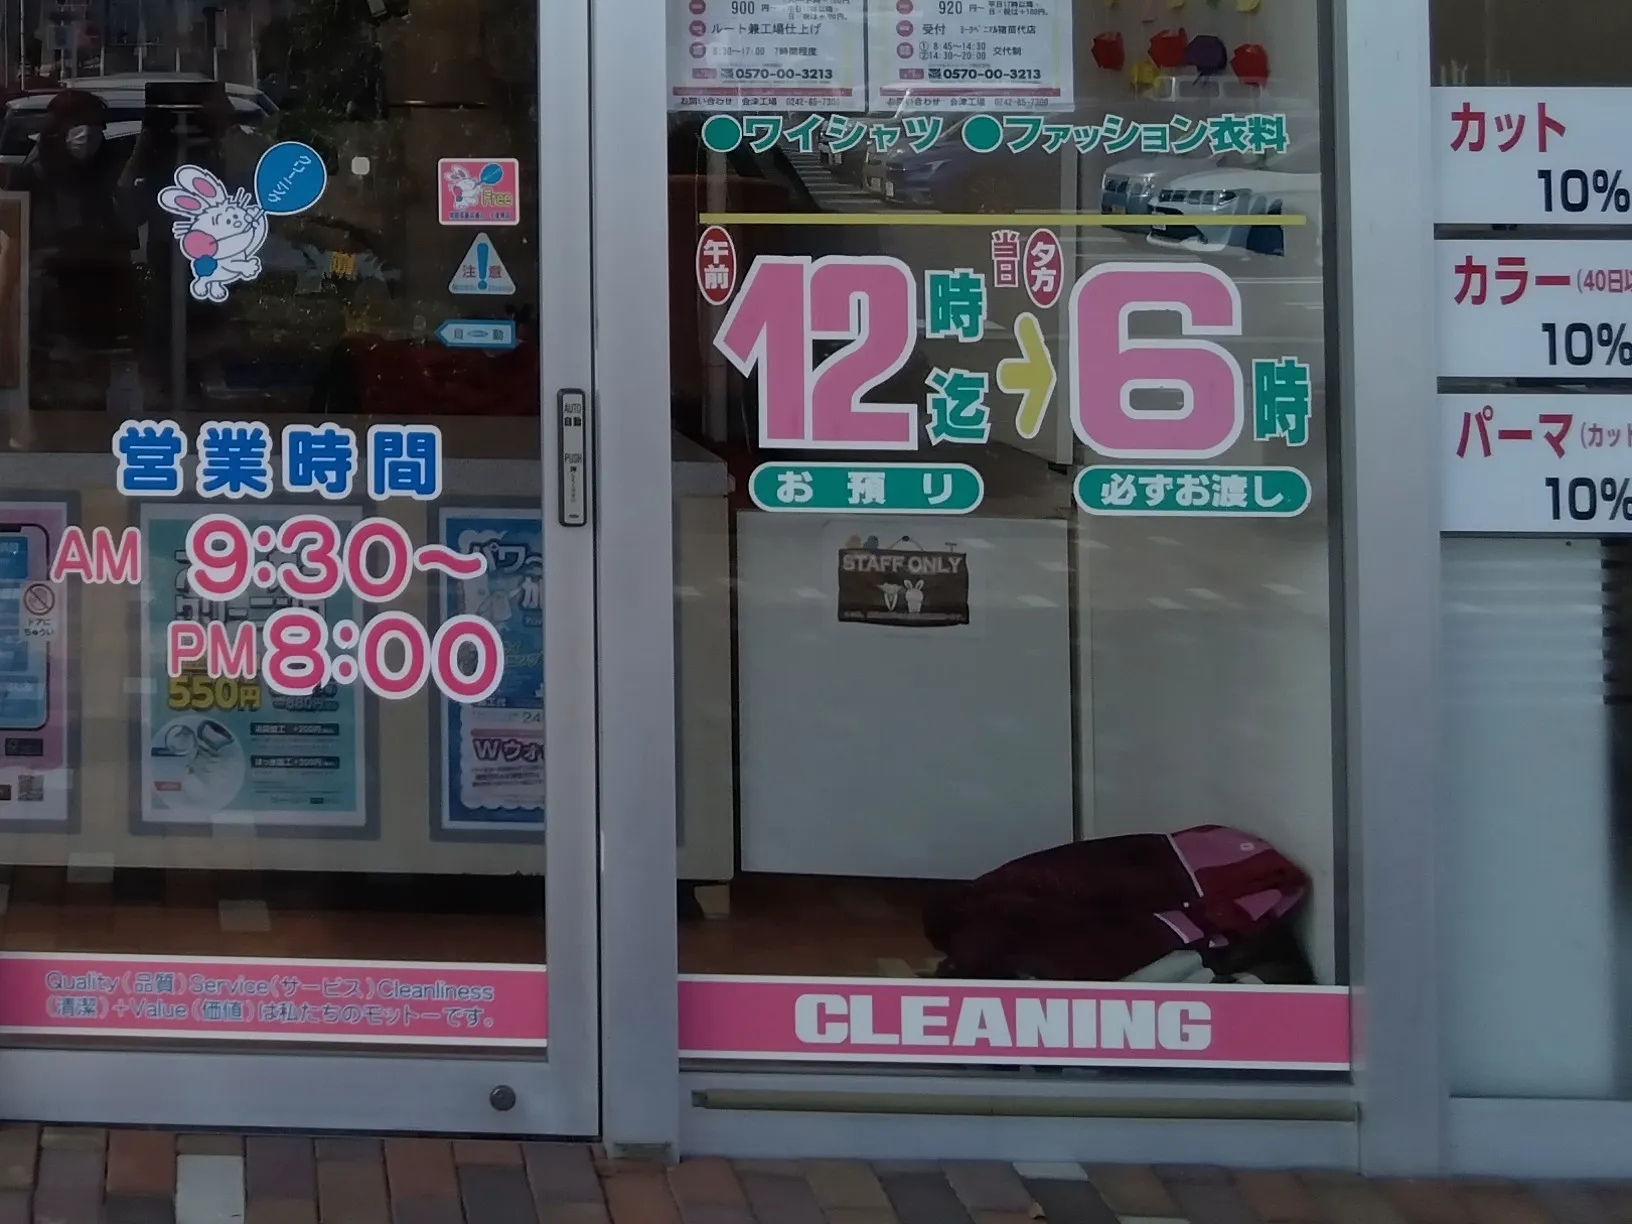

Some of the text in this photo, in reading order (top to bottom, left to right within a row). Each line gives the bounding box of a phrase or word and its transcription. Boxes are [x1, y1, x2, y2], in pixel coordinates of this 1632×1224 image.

[731, 0, 757, 16] 900
[922, 23, 946, 36] 受付
[938, 0, 964, 16] 920
[992, 46, 1022, 57] 交代制
[735, 68, 834, 80] 0570-00-3213
[942, 69, 1042, 80] 0570-00-3213
[742, 114, 1289, 155] ワイシャツ ファッション衣料
[1449, 101, 1567, 153] カット
[480, 188, 513, 207] Free
[1536, 168, 1631, 213] 10%
[701, 238, 731, 291] 午前
[1453, 255, 1572, 306] カラー
[713, 254, 918, 450] 12
[990, 229, 1313, 458] 当日 夕方 6 時
[1541, 322, 1632, 366] 10%
[1455, 404, 1574, 460] パーマ
[114, 420, 441, 500] 営業時間
[1100, 473, 1285, 508] 必ずお渡し
[50, 526, 142, 585] AM
[842, 553, 963, 575] STAFF ONLY
[167, 607, 504, 702] PM 8:00
[46, 971, 118, 995] Quality
[377, 979, 494, 1003] Cleanliness
[794, 993, 1212, 1051] CLEANING
